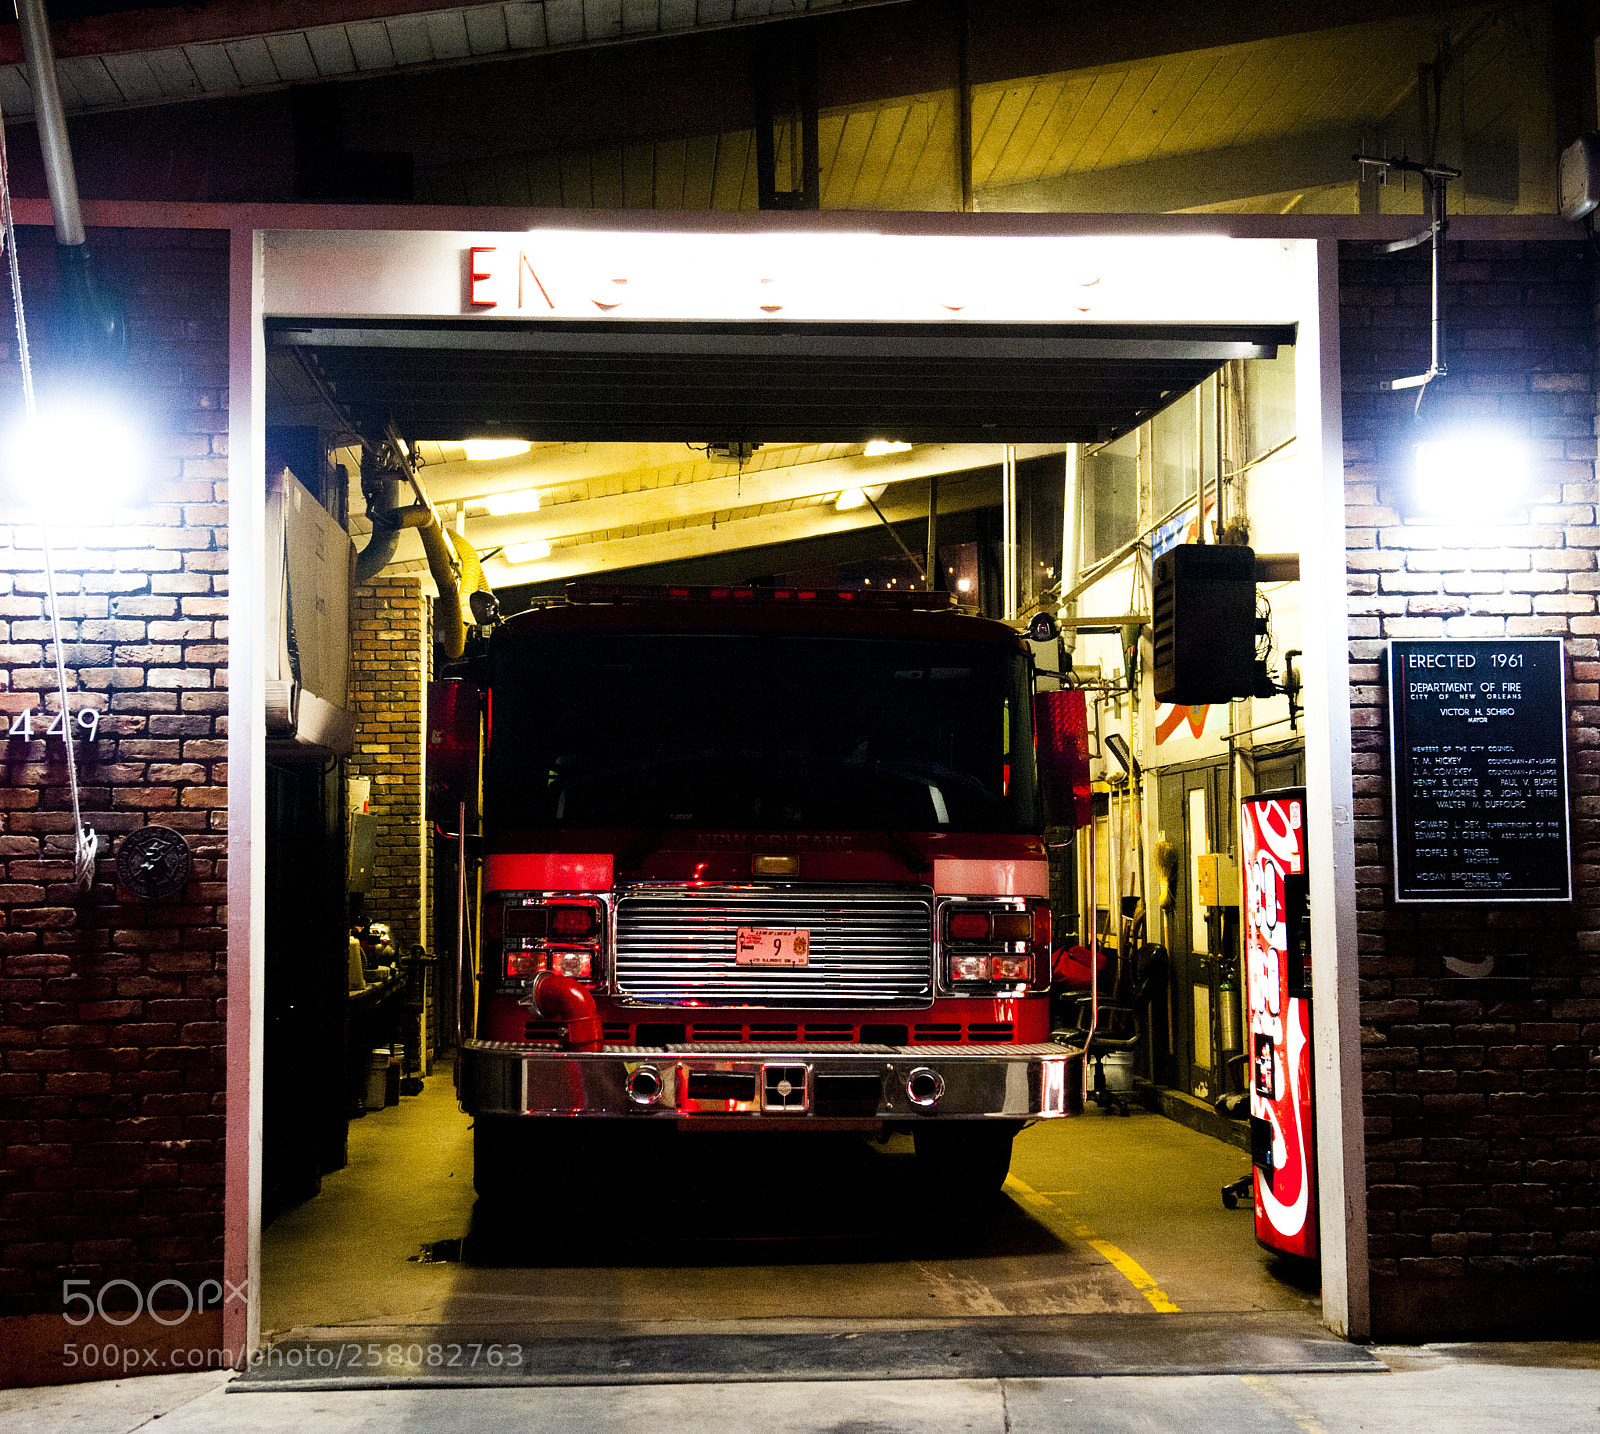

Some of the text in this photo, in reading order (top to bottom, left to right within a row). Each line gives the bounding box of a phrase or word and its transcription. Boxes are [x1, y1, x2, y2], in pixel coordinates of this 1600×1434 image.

[1409, 654, 1523, 668] ERECTED 1961
[1410, 682, 1521, 693] DEPARTMENT OF FIRE
[1440, 708, 1470, 716] VICTOR
[1486, 708, 1515, 716] SCHIRO
[9, 708, 100, 742] 449
[1414, 831, 1447, 839] EDWARD
[1415, 848, 1448, 857] STOFFLE
[1463, 848, 1490, 857] FINGER
[1416, 872, 1446, 880] HOGAN
[773, 938, 782, 956] 9
